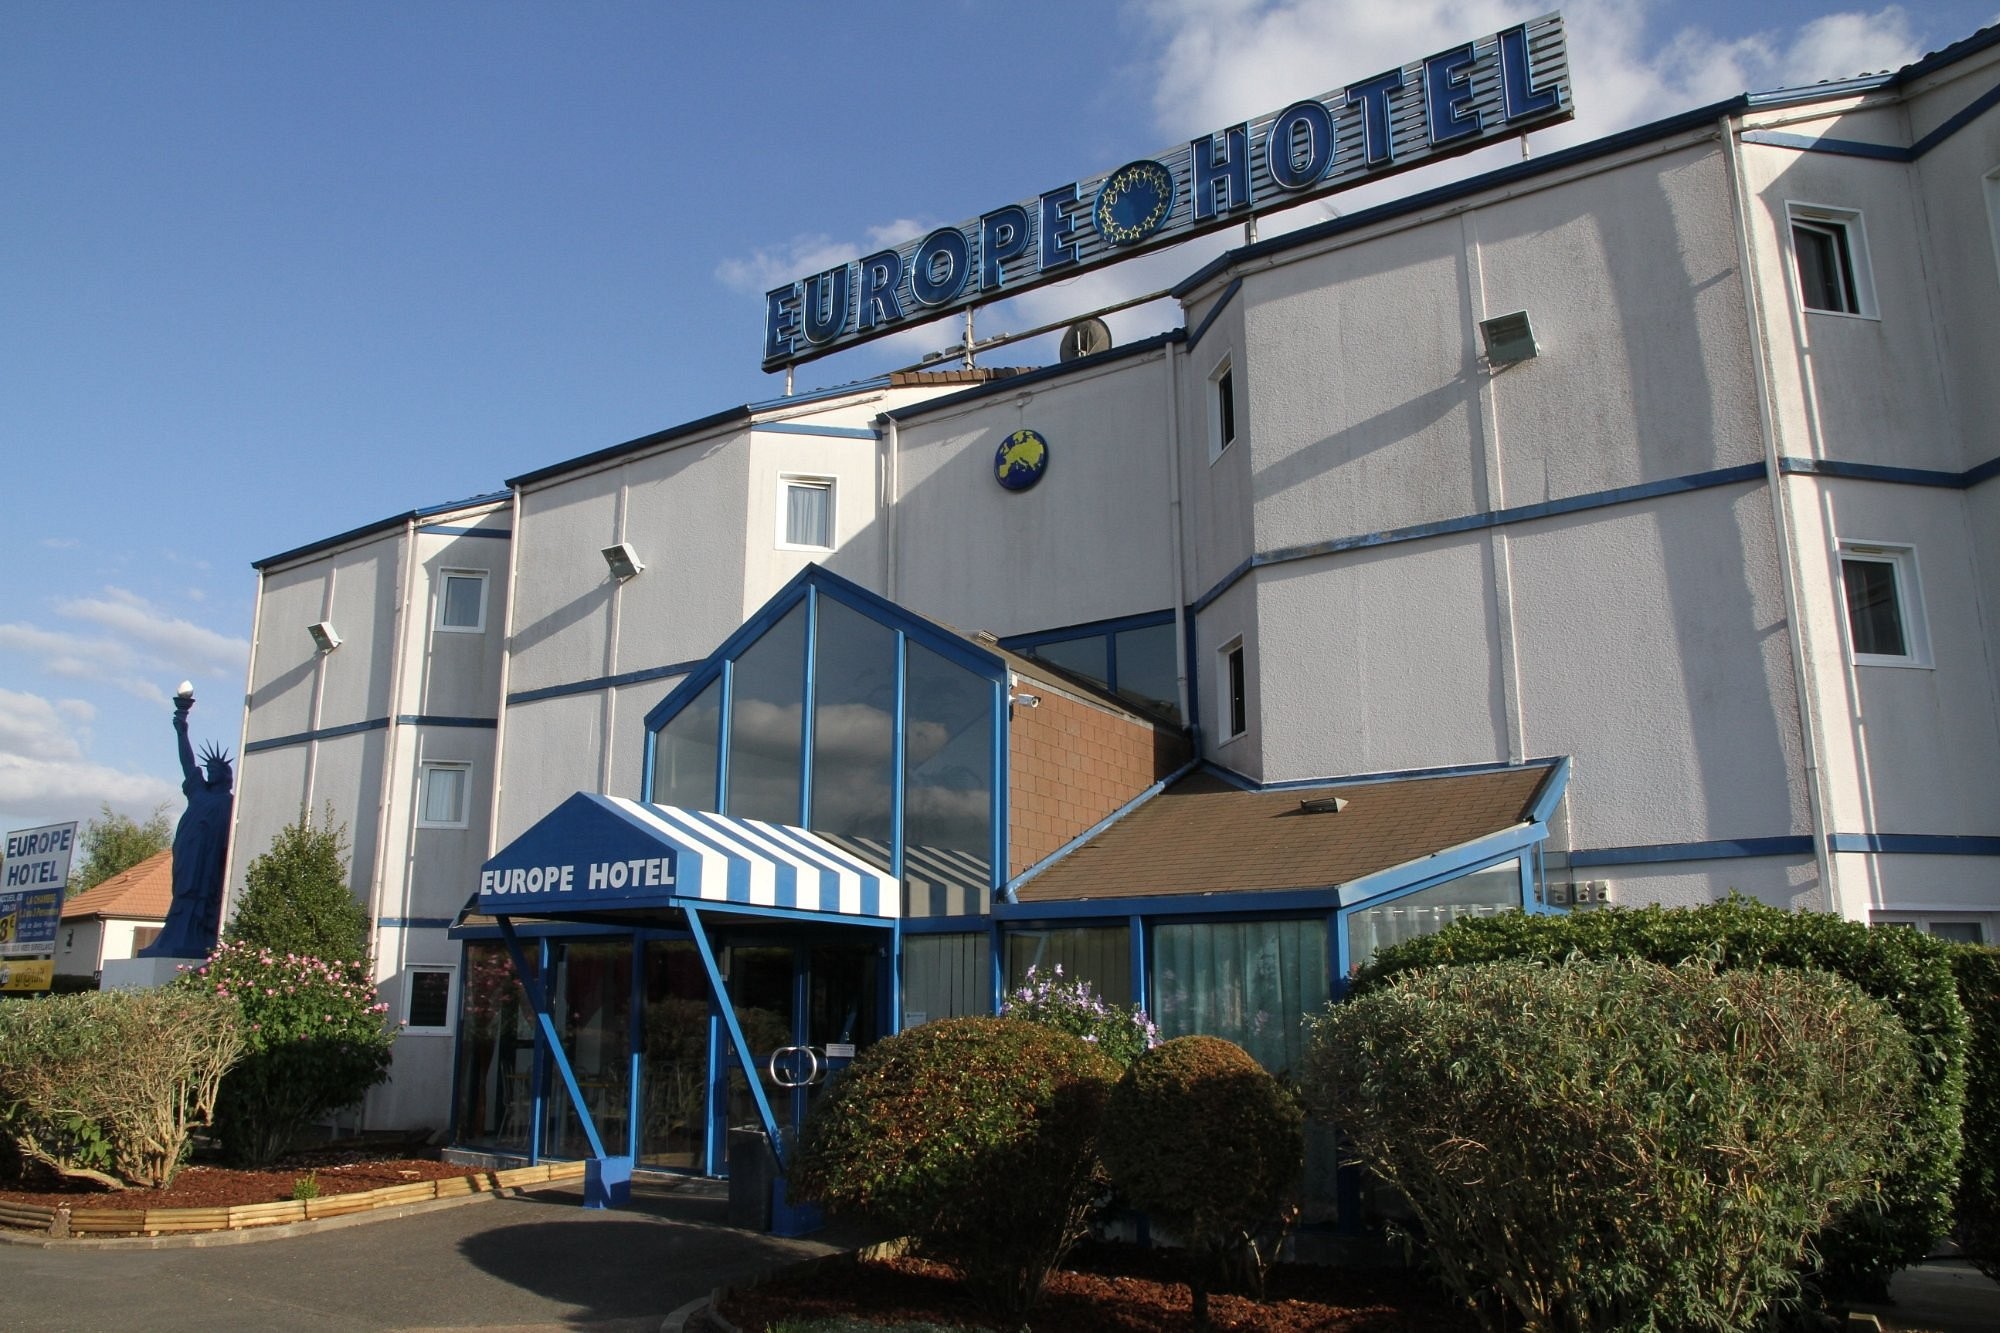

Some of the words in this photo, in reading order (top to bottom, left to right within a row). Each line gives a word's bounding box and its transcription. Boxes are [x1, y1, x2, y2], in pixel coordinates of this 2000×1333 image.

[763, 182, 1081, 363] EUROPE
[1191, 23, 1562, 221] HOTEL
[6, 828, 71, 859] EUROPE
[7, 860, 59, 887] HOTEL
[480, 865, 574, 896] EUROPE
[588, 857, 675, 890] HOTEL
